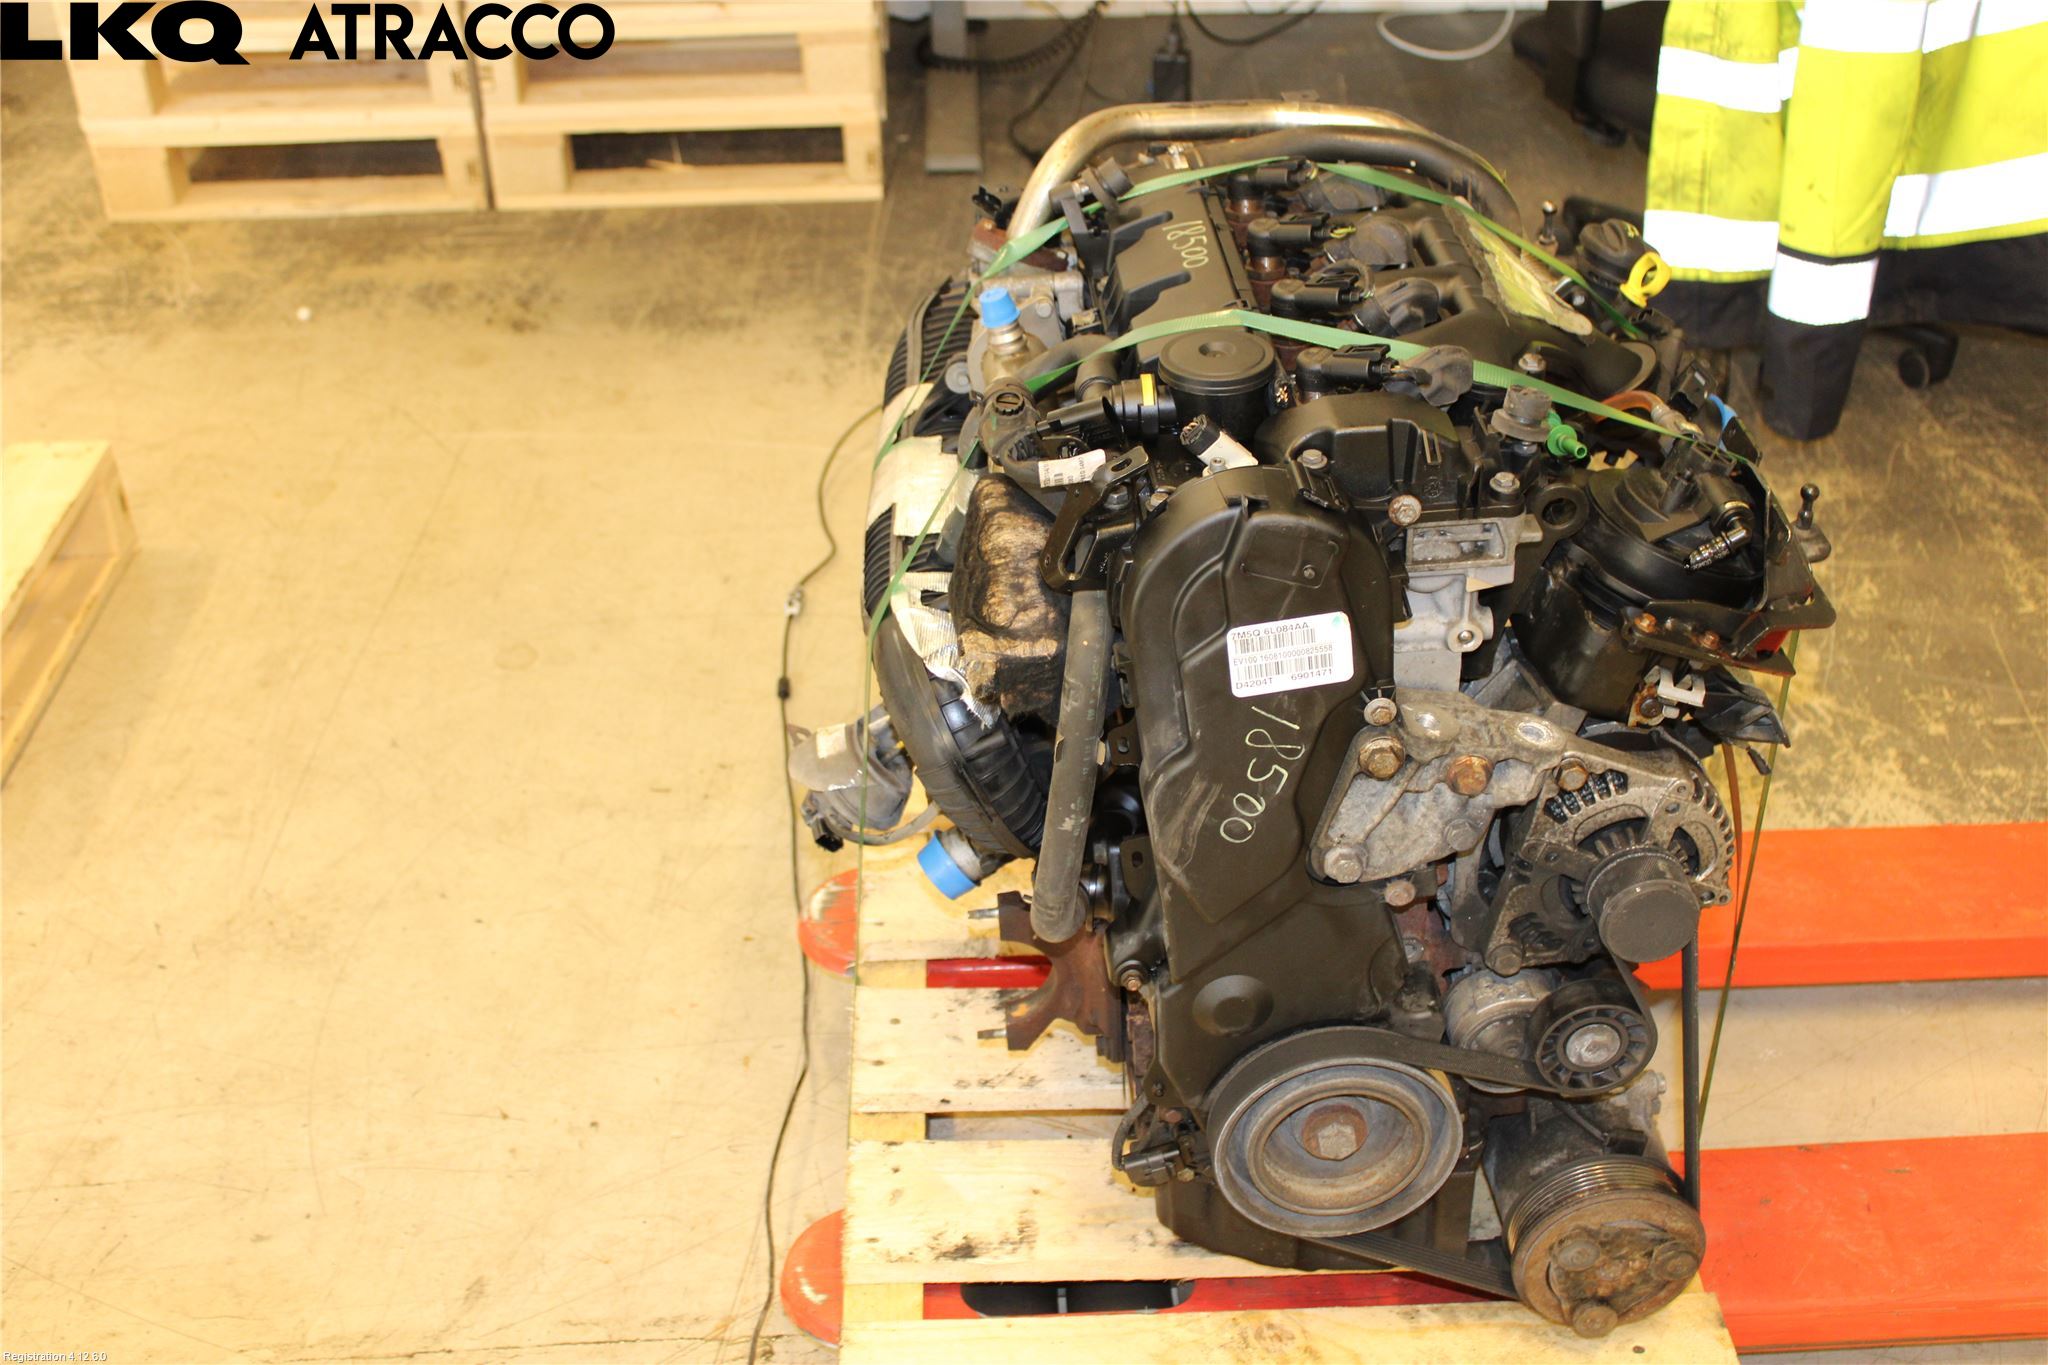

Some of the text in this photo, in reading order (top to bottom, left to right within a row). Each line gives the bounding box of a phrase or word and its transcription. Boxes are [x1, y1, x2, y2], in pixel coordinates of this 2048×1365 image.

[1162, 220, 1209, 268] 18500
[1231, 622, 1309, 640] 7M5Q 6L084AA
[1236, 668, 1333, 690] D4204T 6901471
[1220, 706, 1306, 844] 18500
